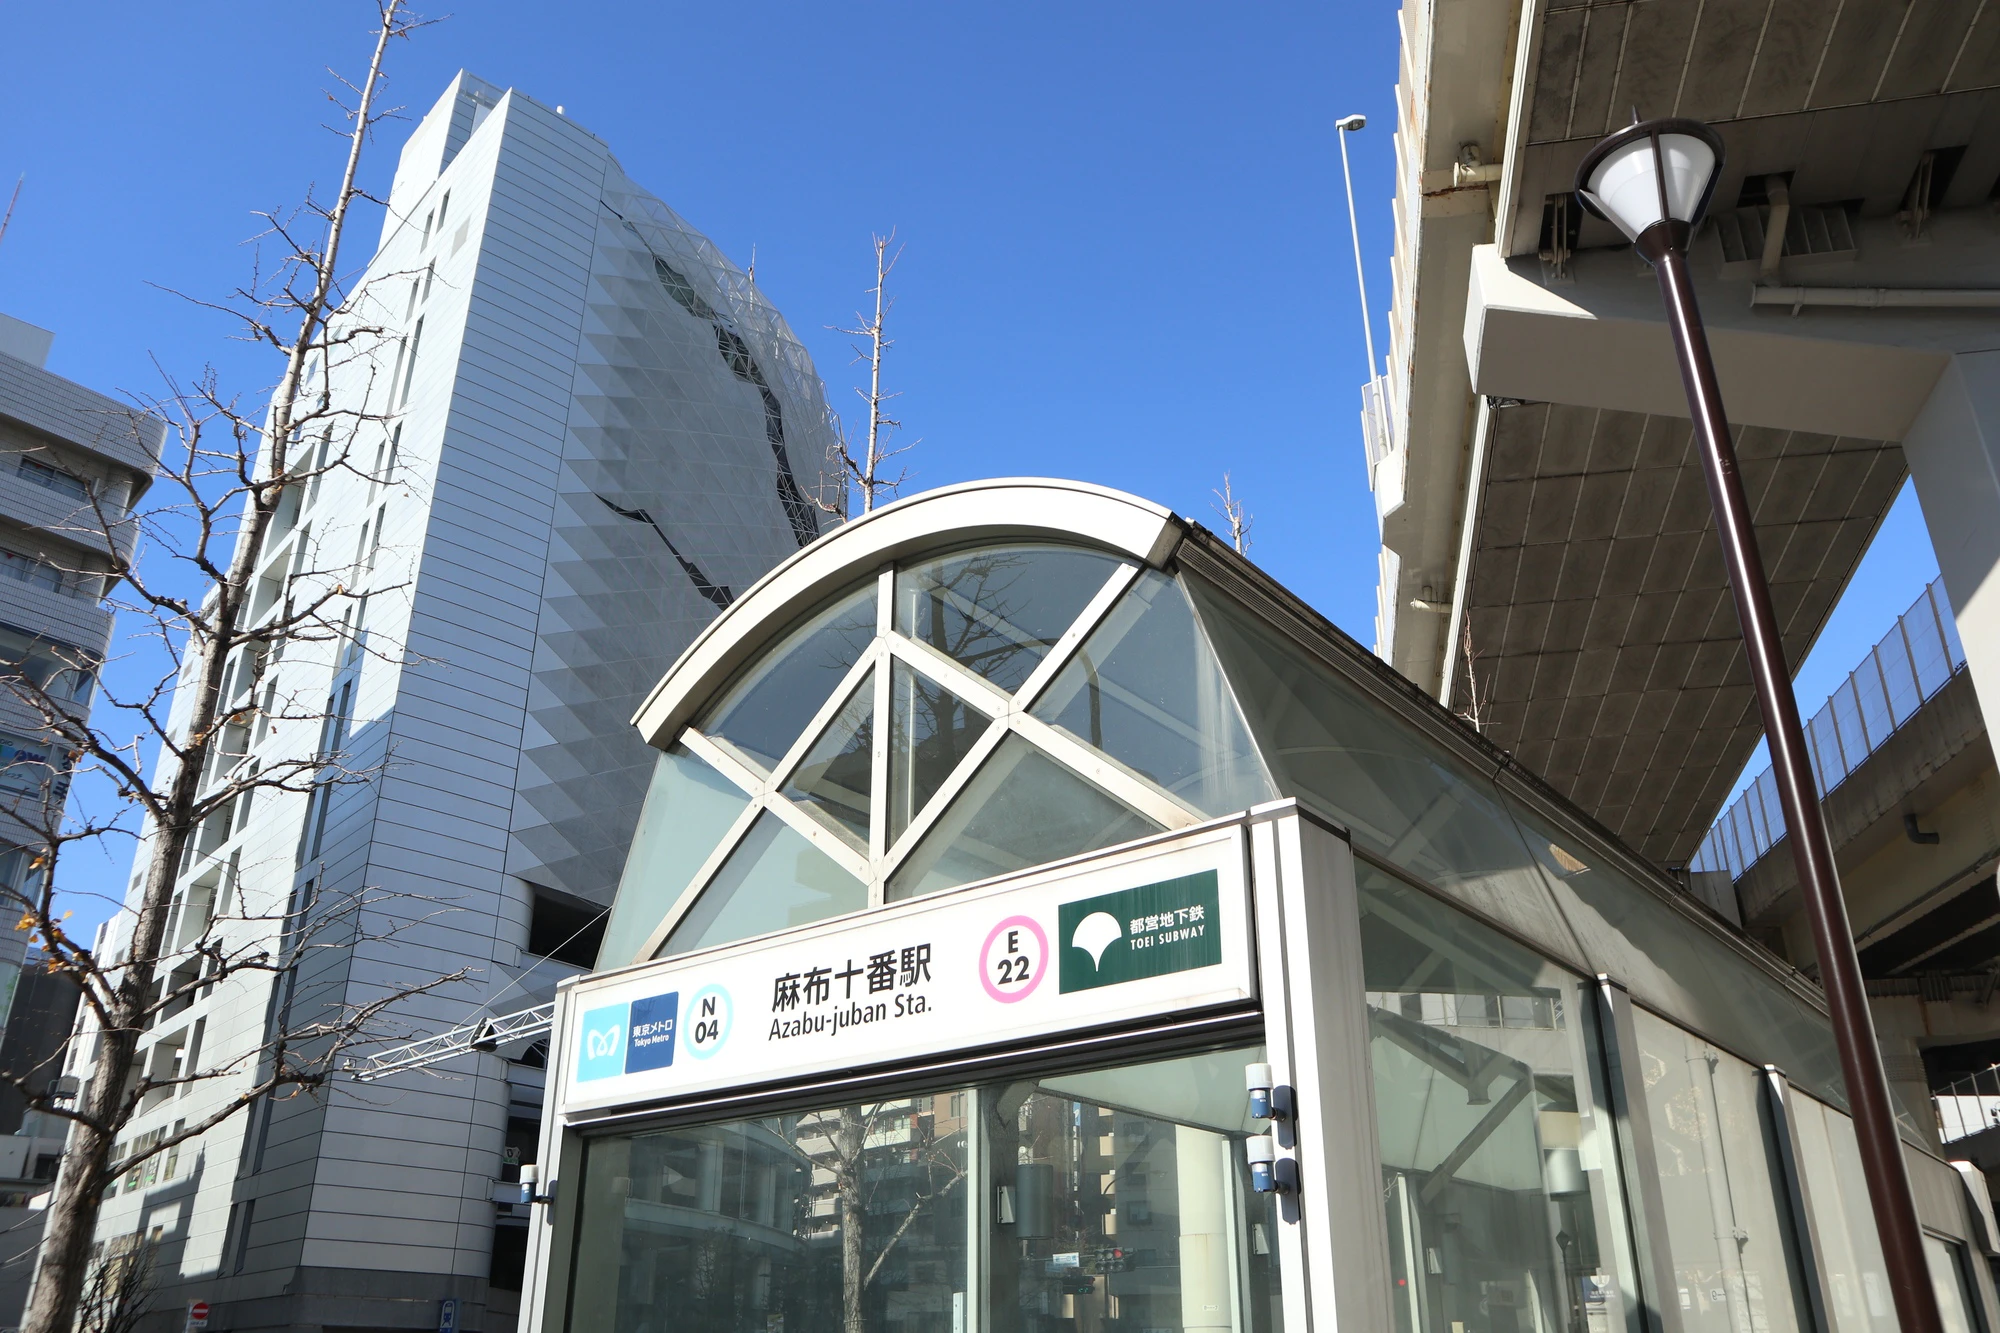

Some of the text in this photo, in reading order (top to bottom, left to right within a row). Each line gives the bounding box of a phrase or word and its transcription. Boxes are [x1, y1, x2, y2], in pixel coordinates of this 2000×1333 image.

[1129, 904, 1205, 935] 都営地下鉄
[1007, 930, 1019, 954] E
[1130, 924, 1205, 951] TOEI SUBWAY
[771, 943, 932, 1013] 麻布十番駅
[997, 955, 1030, 985] 22
[702, 996, 716, 1018] N
[768, 993, 932, 1041] Azabu-juban Sta.
[632, 1018, 673, 1038] 東京メトロ
[634, 1034, 670, 1048] Tokyo Metro
[694, 1019, 719, 1044] 04
